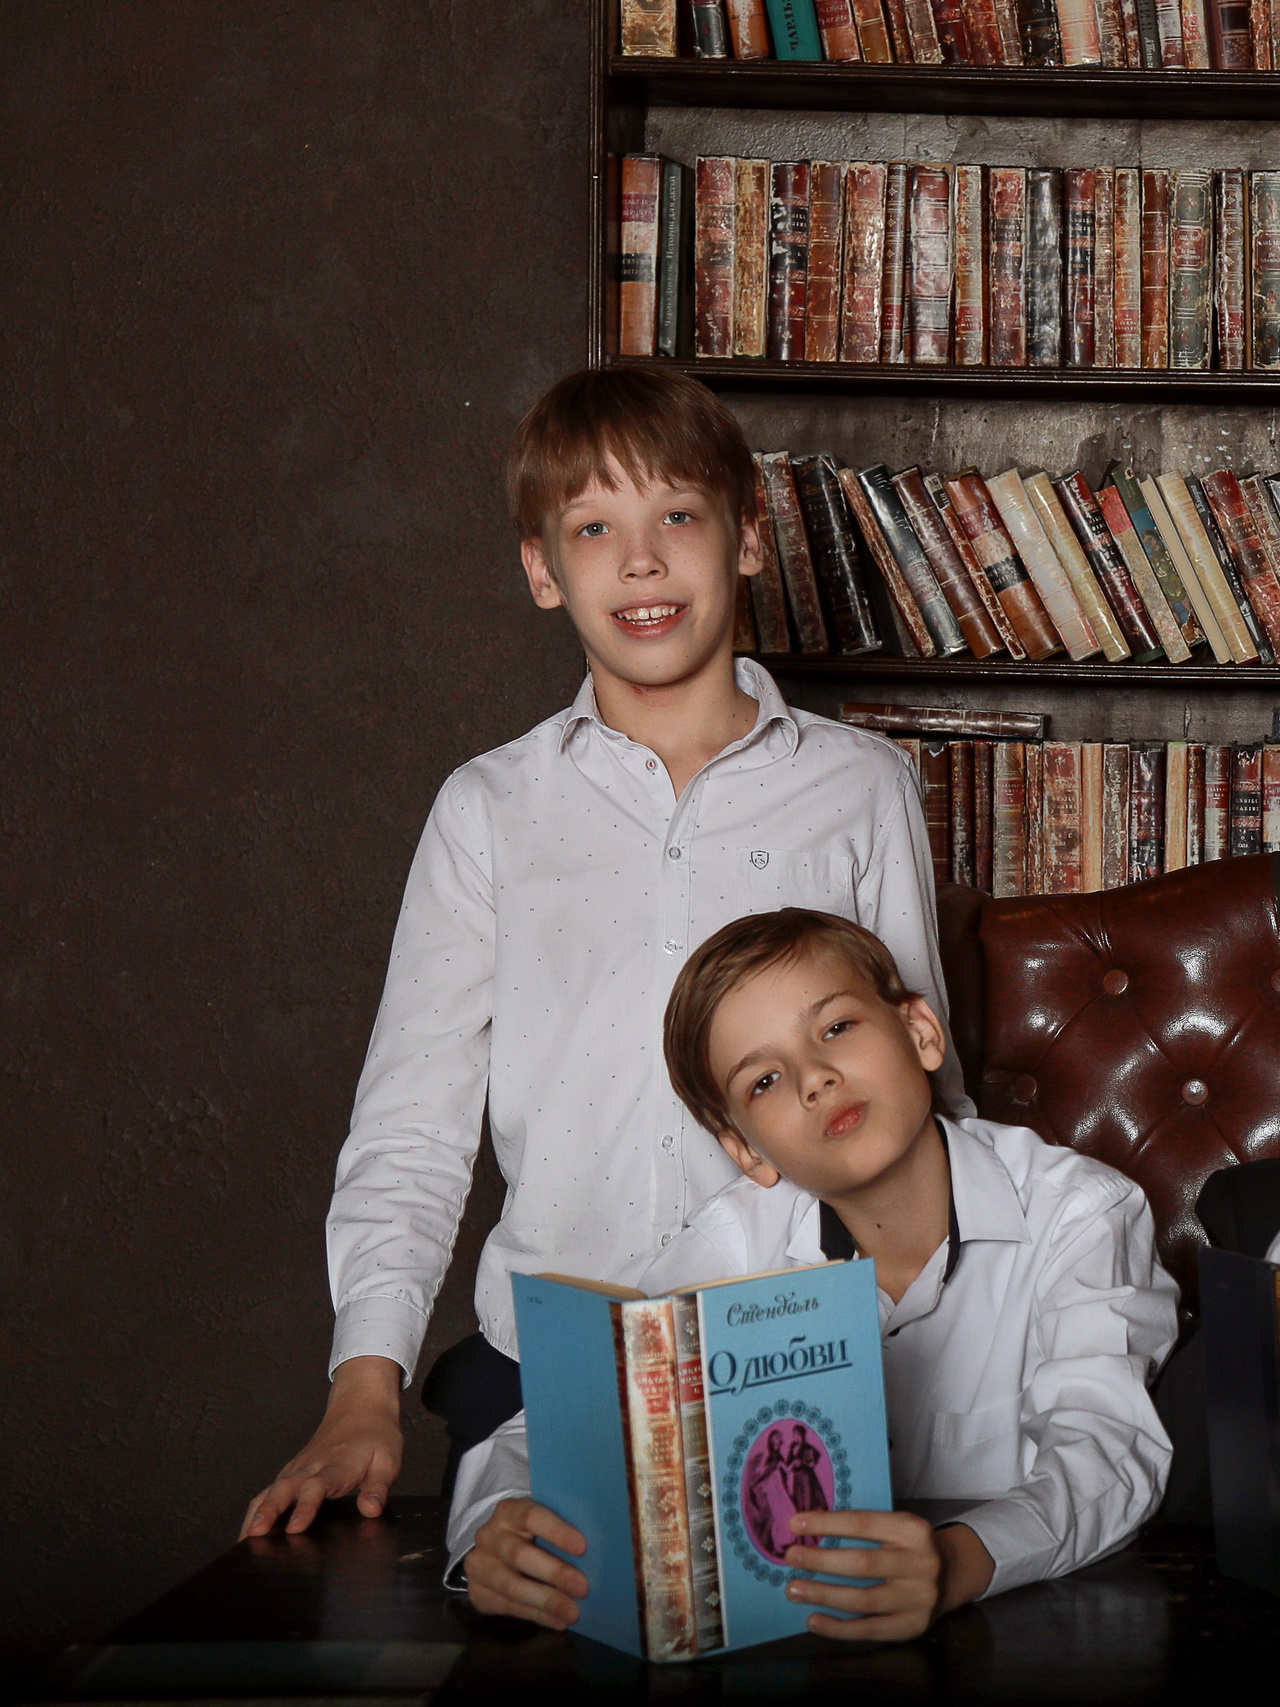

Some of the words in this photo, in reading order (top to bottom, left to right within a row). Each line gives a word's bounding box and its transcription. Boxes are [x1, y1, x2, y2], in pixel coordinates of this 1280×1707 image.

[669, 175, 677, 199] детей
[668, 202, 677, 220] для
[666, 221, 675, 259] Истории
[725, 1292, 820, 1328] Стендаль
[708, 1350, 734, 1386] О
